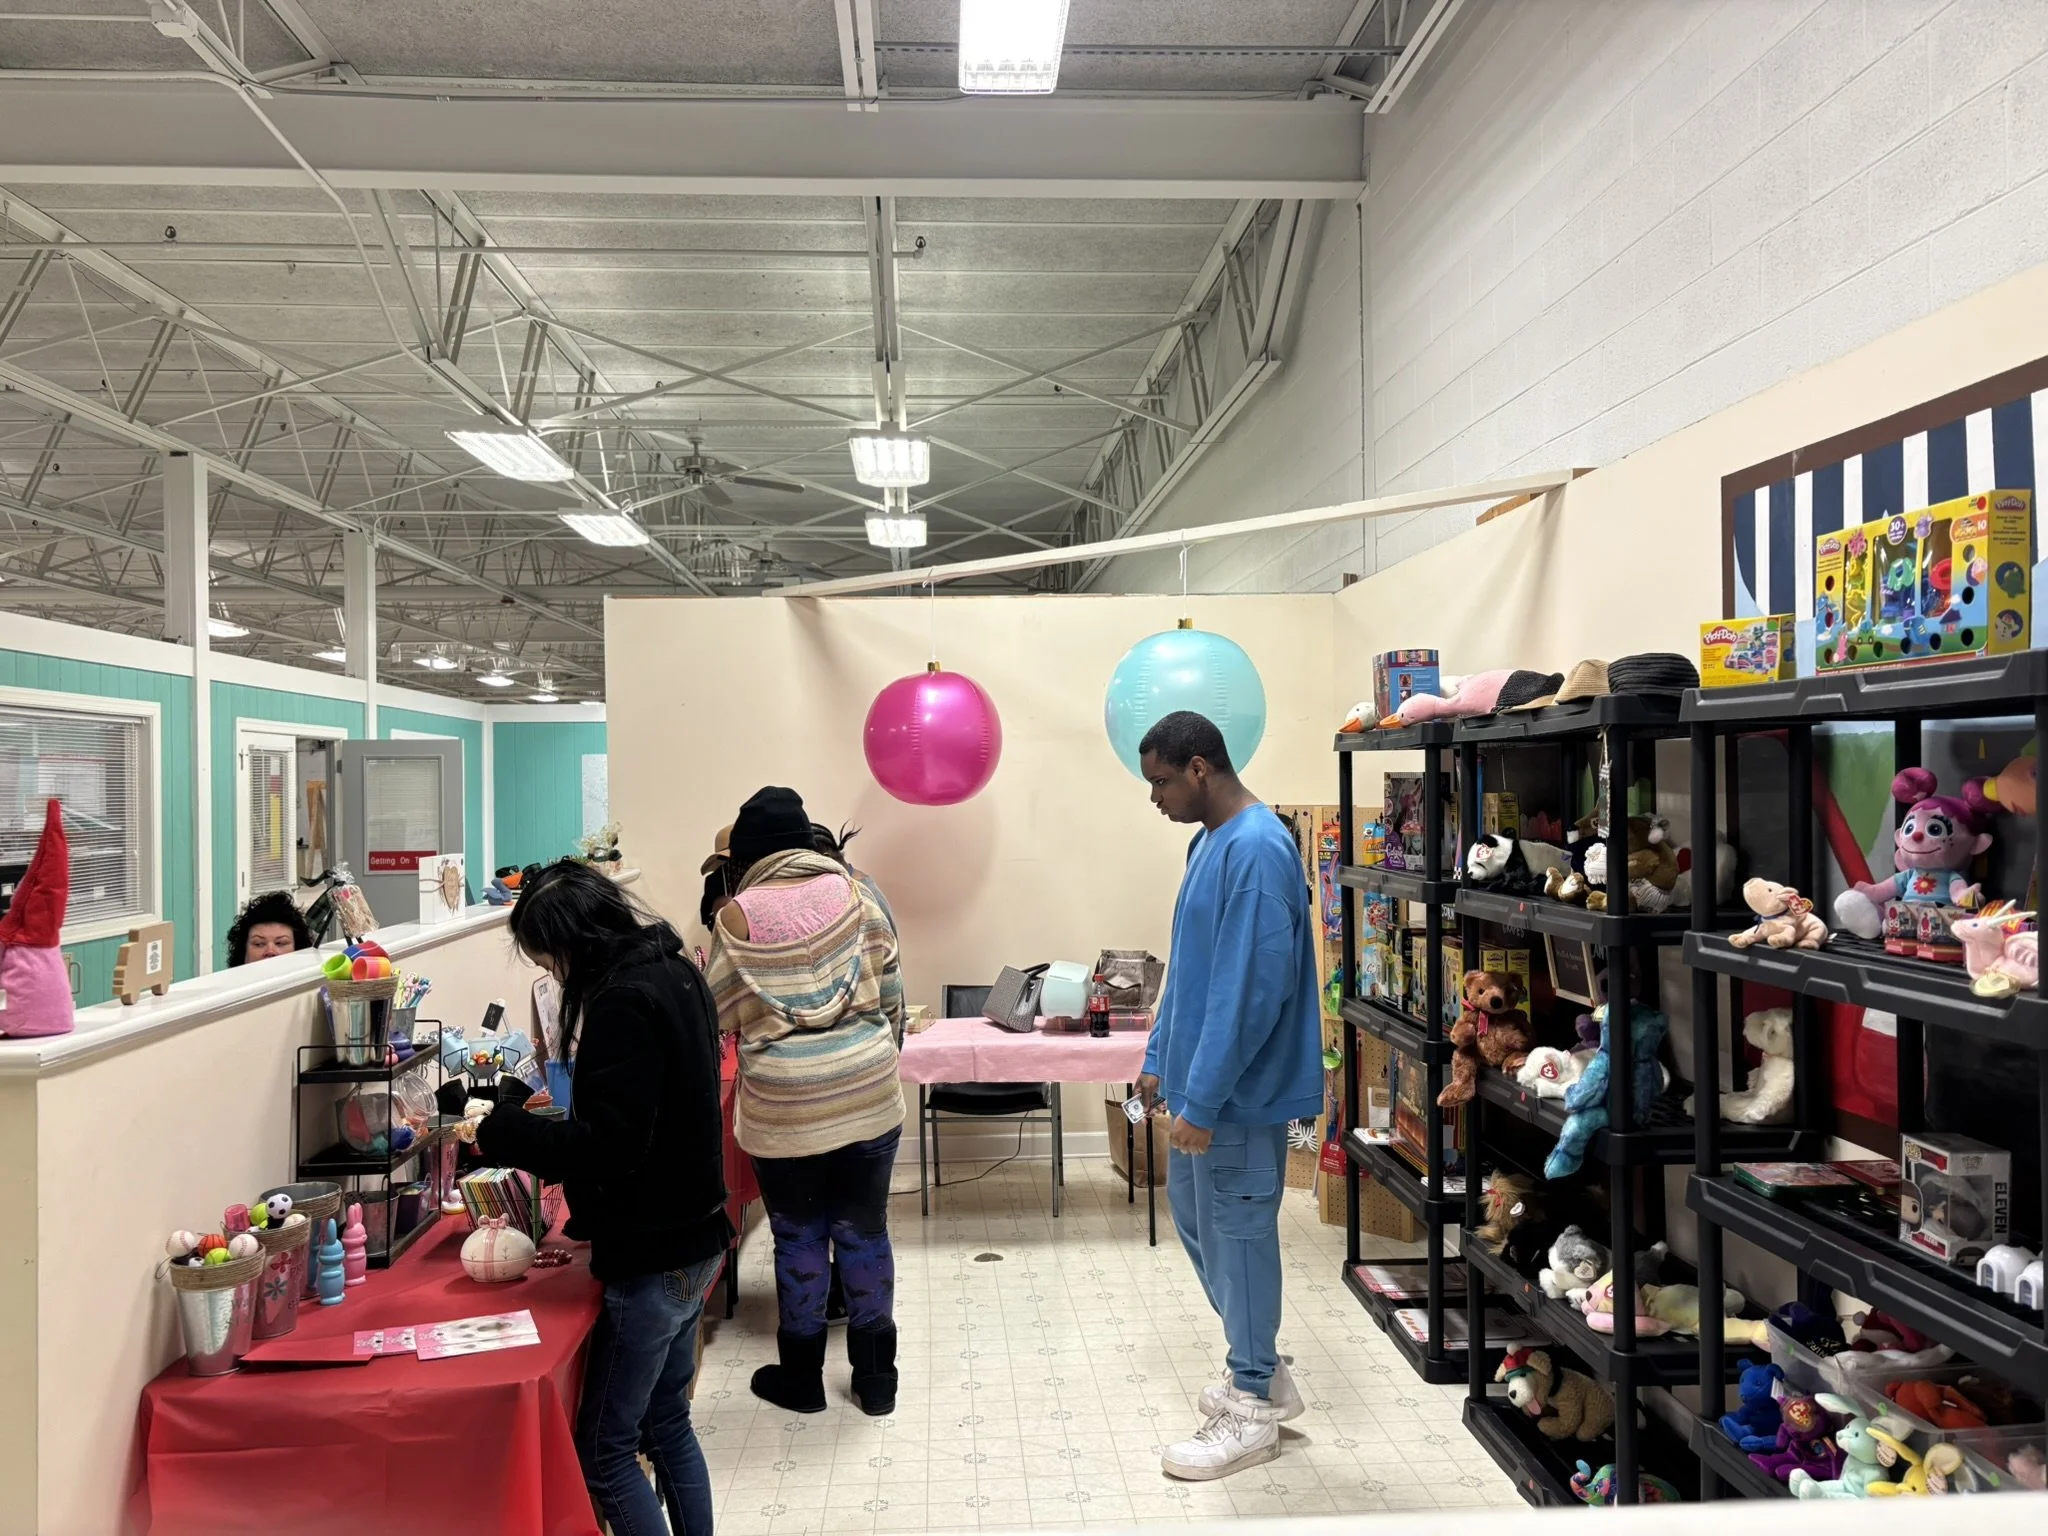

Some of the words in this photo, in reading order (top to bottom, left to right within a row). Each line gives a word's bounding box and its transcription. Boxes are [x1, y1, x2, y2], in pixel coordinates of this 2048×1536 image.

[371, 856, 396, 867] Getting
[399, 856, 410, 865] On
[1994, 1182, 2007, 1234] ELEVEN
